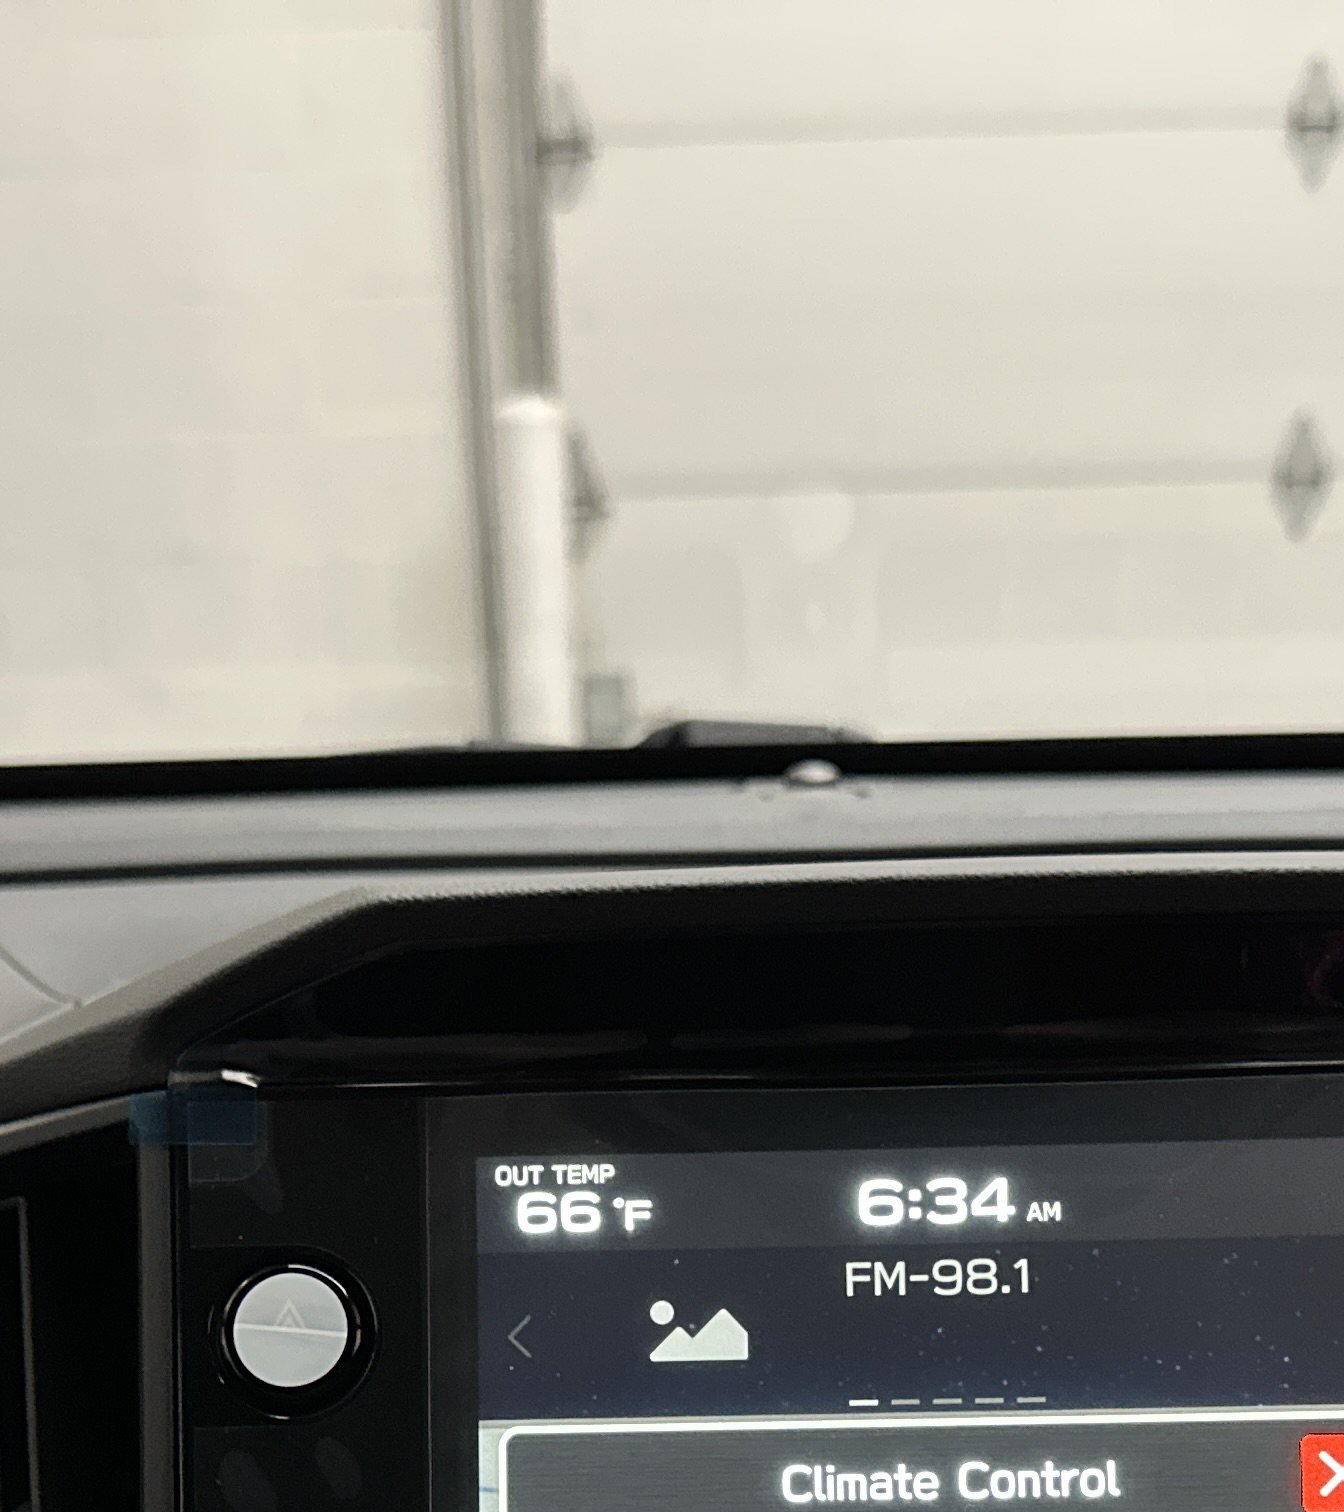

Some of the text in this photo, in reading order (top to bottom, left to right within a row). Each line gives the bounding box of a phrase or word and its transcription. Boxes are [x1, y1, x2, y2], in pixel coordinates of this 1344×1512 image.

[495, 1164, 616, 1187] OUT TEMP
[517, 1191, 601, 1235] 66
[857, 1177, 1062, 1227] 6:34 AM
[845, 1258, 1030, 1297] FM-98.1
[781, 1459, 1122, 1504] Climate Control
